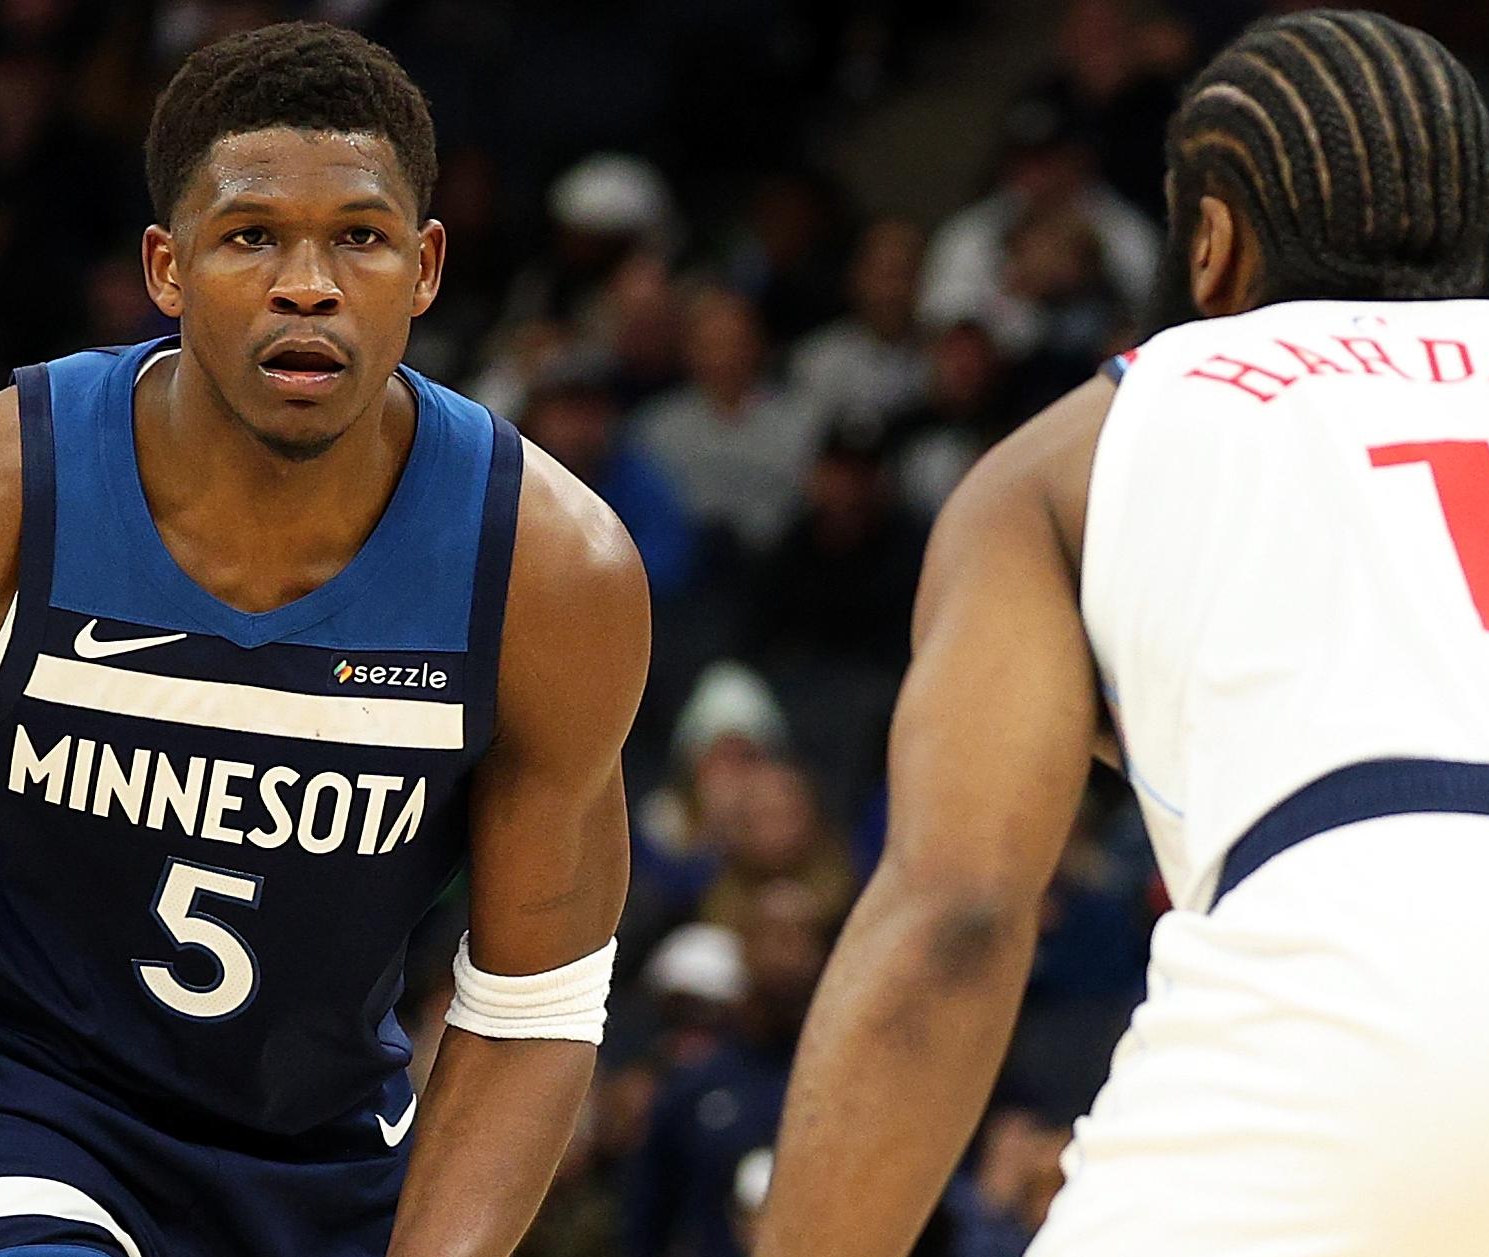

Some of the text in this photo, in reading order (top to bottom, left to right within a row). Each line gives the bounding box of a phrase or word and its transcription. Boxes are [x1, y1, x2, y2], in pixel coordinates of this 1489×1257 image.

[353, 662, 448, 689] sezzle
[8, 724, 426, 855] MINNESOTA
[132, 857, 264, 1023] 5
